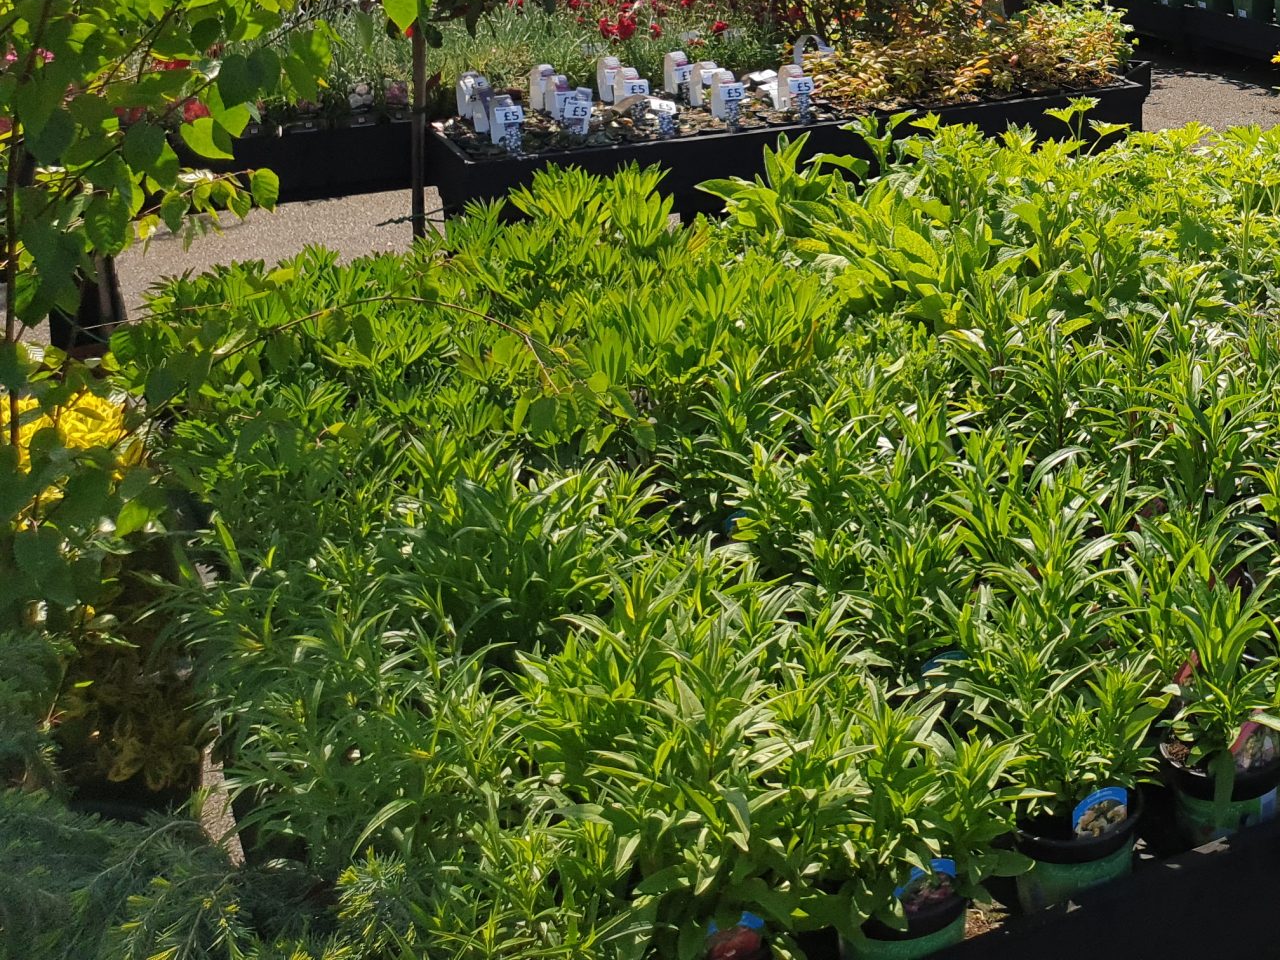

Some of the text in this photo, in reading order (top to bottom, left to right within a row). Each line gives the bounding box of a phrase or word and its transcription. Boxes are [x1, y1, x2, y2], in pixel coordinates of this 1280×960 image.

[631, 84, 645, 94] £5
[797, 82, 811, 92] £5
[727, 88, 742, 98] £5
[573, 106, 588, 117] £5
[659, 103, 673, 111] £5
[504, 110, 519, 121] £5
